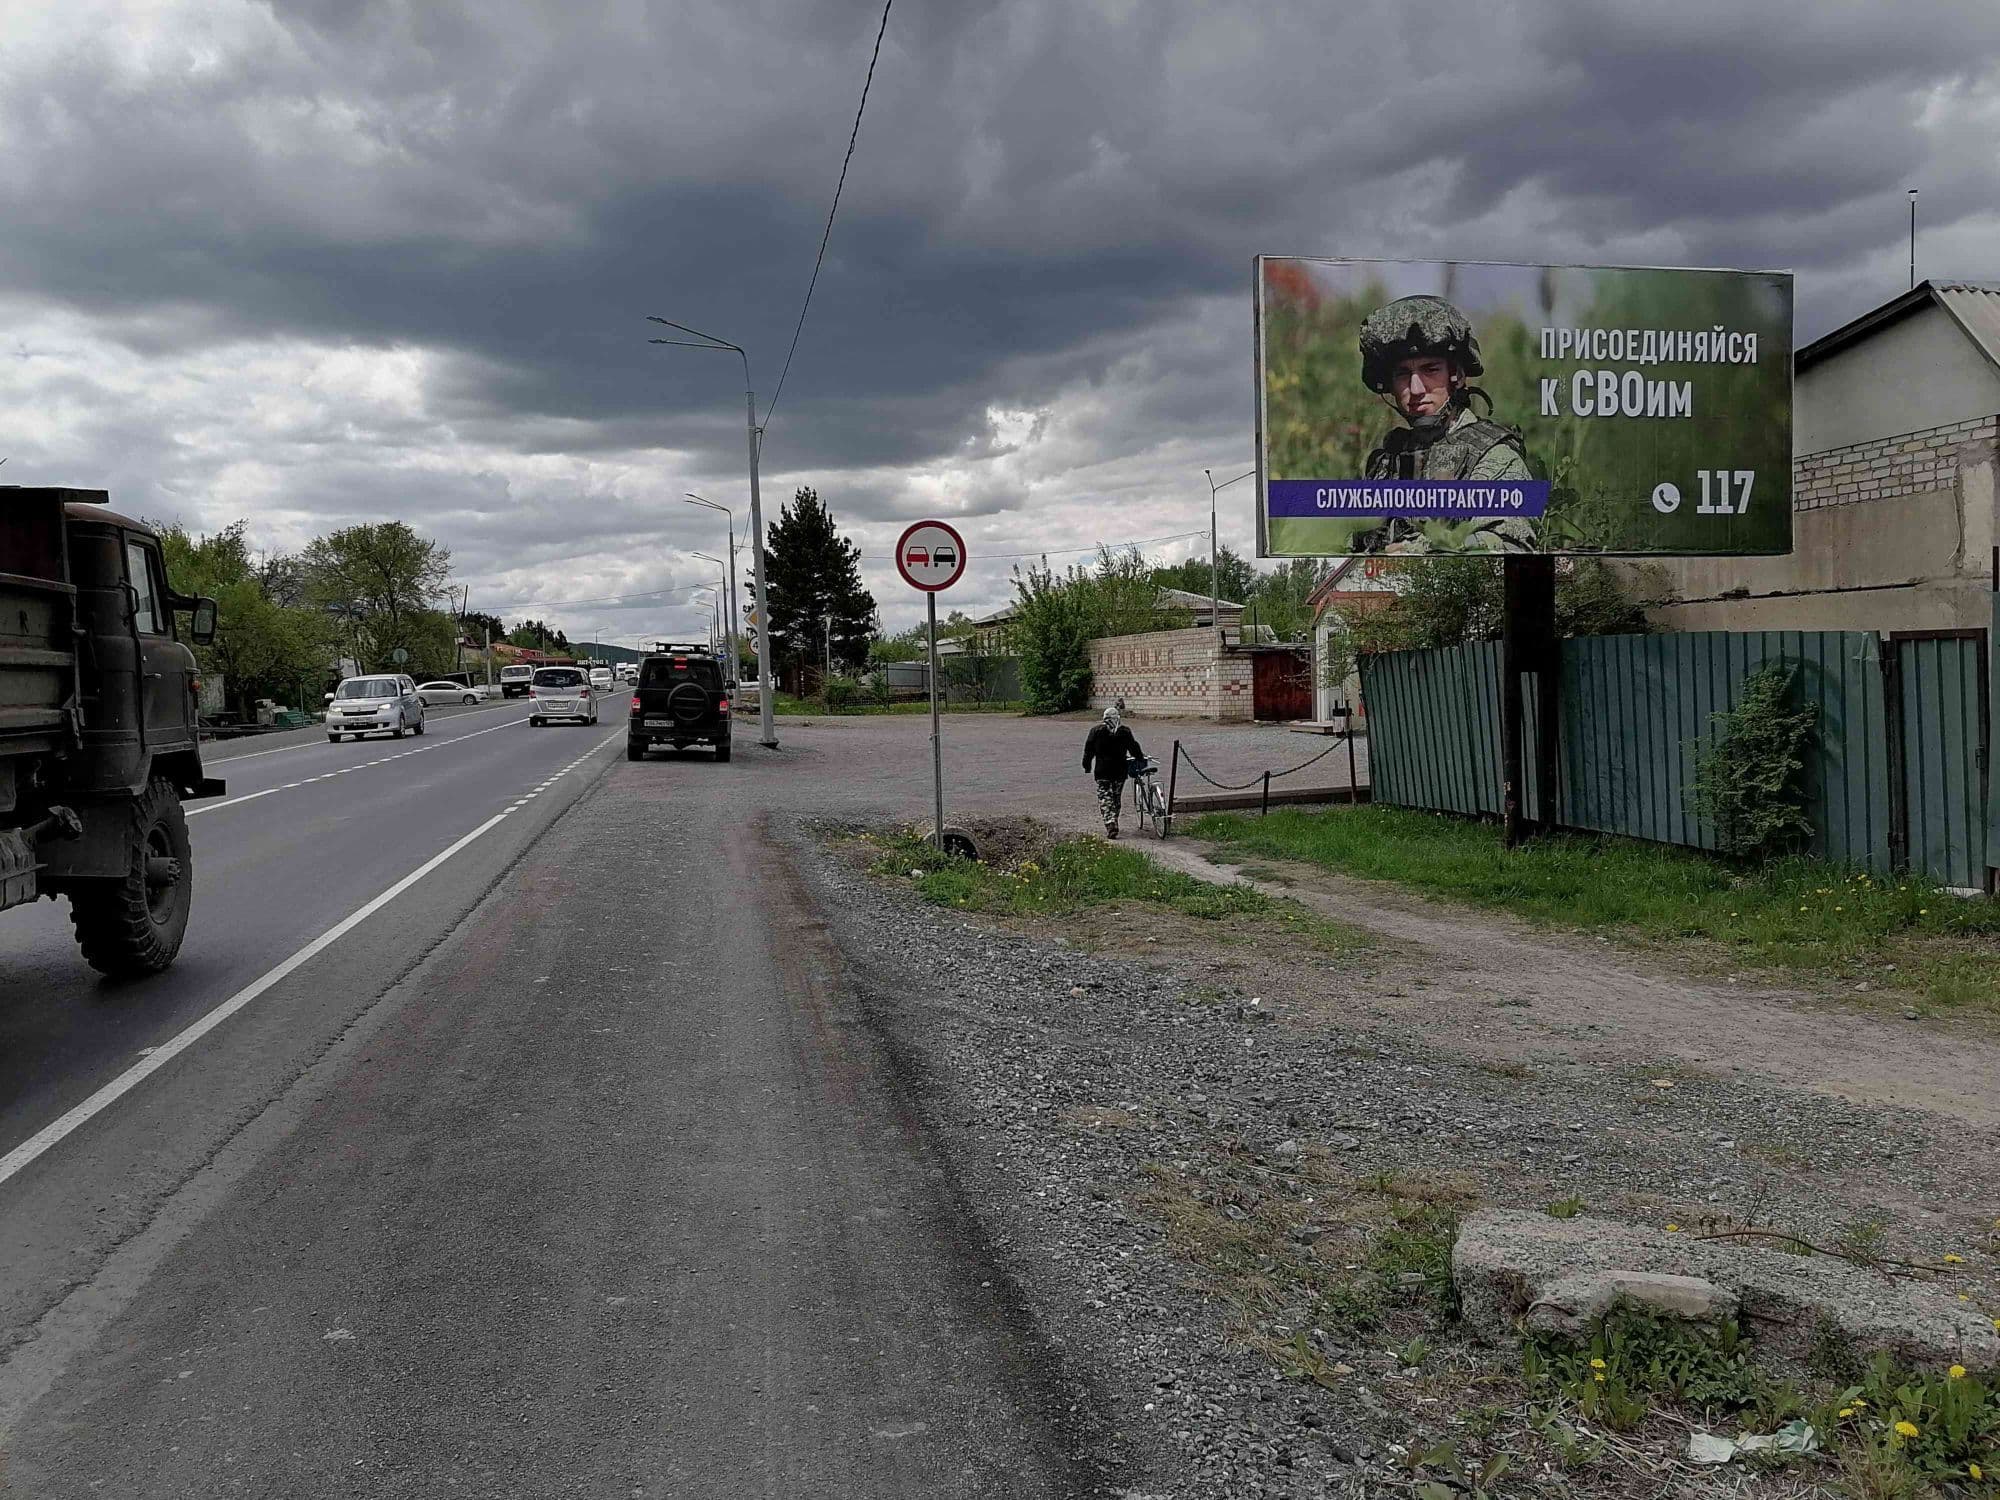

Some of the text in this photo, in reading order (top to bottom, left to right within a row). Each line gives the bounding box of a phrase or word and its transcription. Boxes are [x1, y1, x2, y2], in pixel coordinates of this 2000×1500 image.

[1541, 325, 1758, 365] ПРИСОЕДИНЯЙСЯ
[1316, 488, 1524, 509] СЛУЖБАПОКОНТРАКТУ.РФ
[1697, 470, 1755, 514] 117
